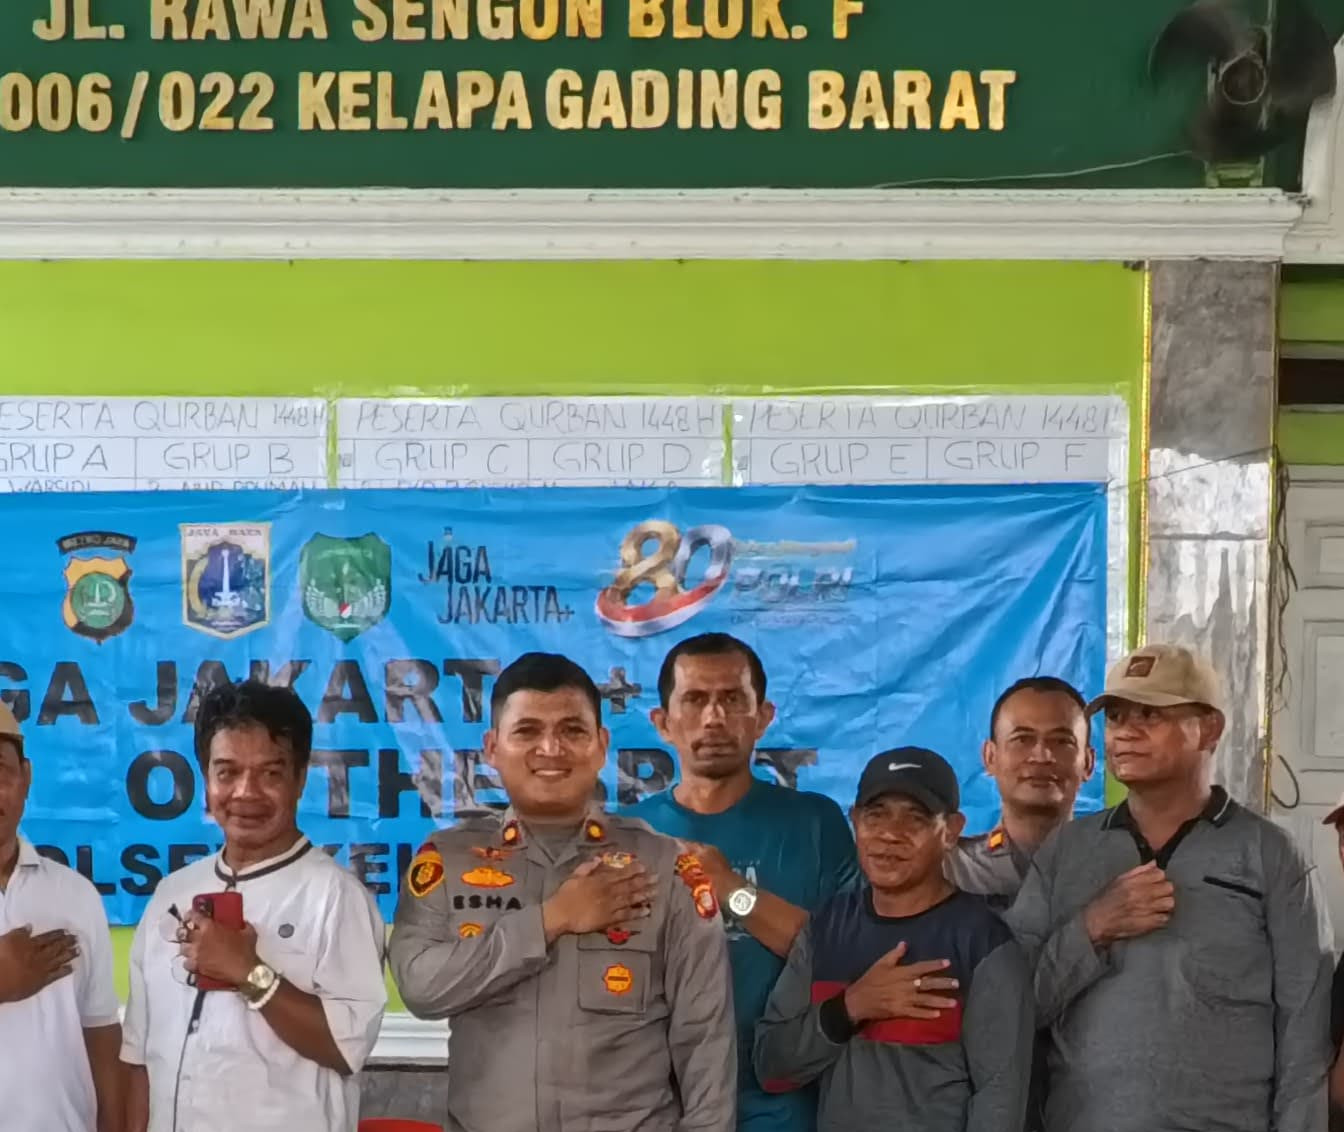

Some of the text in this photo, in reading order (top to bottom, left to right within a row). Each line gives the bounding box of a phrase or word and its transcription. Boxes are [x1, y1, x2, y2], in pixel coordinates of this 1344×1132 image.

[33, 0, 124, 40] JL.
[151, 0, 328, 40] RAWA
[352, 0, 603, 41] SENGON
[629, 0, 807, 40] BLOK.
[298, 69, 532, 131] KELAPA
[545, 68, 782, 130] GADING
[808, 69, 1016, 131] BARAT
[133, 401, 258, 432] QURBAN
[357, 403, 480, 433] PESERTA
[500, 403, 626, 433] QURBAN
[750, 402, 877, 433] PESERTA
[895, 403, 1024, 432] QURBAN
[81, 444, 108, 471] A
[163, 442, 294, 473] GRUP B
[375, 442, 468, 474] GRUP
[487, 444, 510, 474] C
[553, 442, 691, 474] GRUP D
[770, 442, 869, 475] GRUP
[890, 444, 913, 475] E
[944, 441, 1088, 472] GRUP F
[418, 540, 492, 585] JAGA
[453, 894, 522, 911] ESHA
